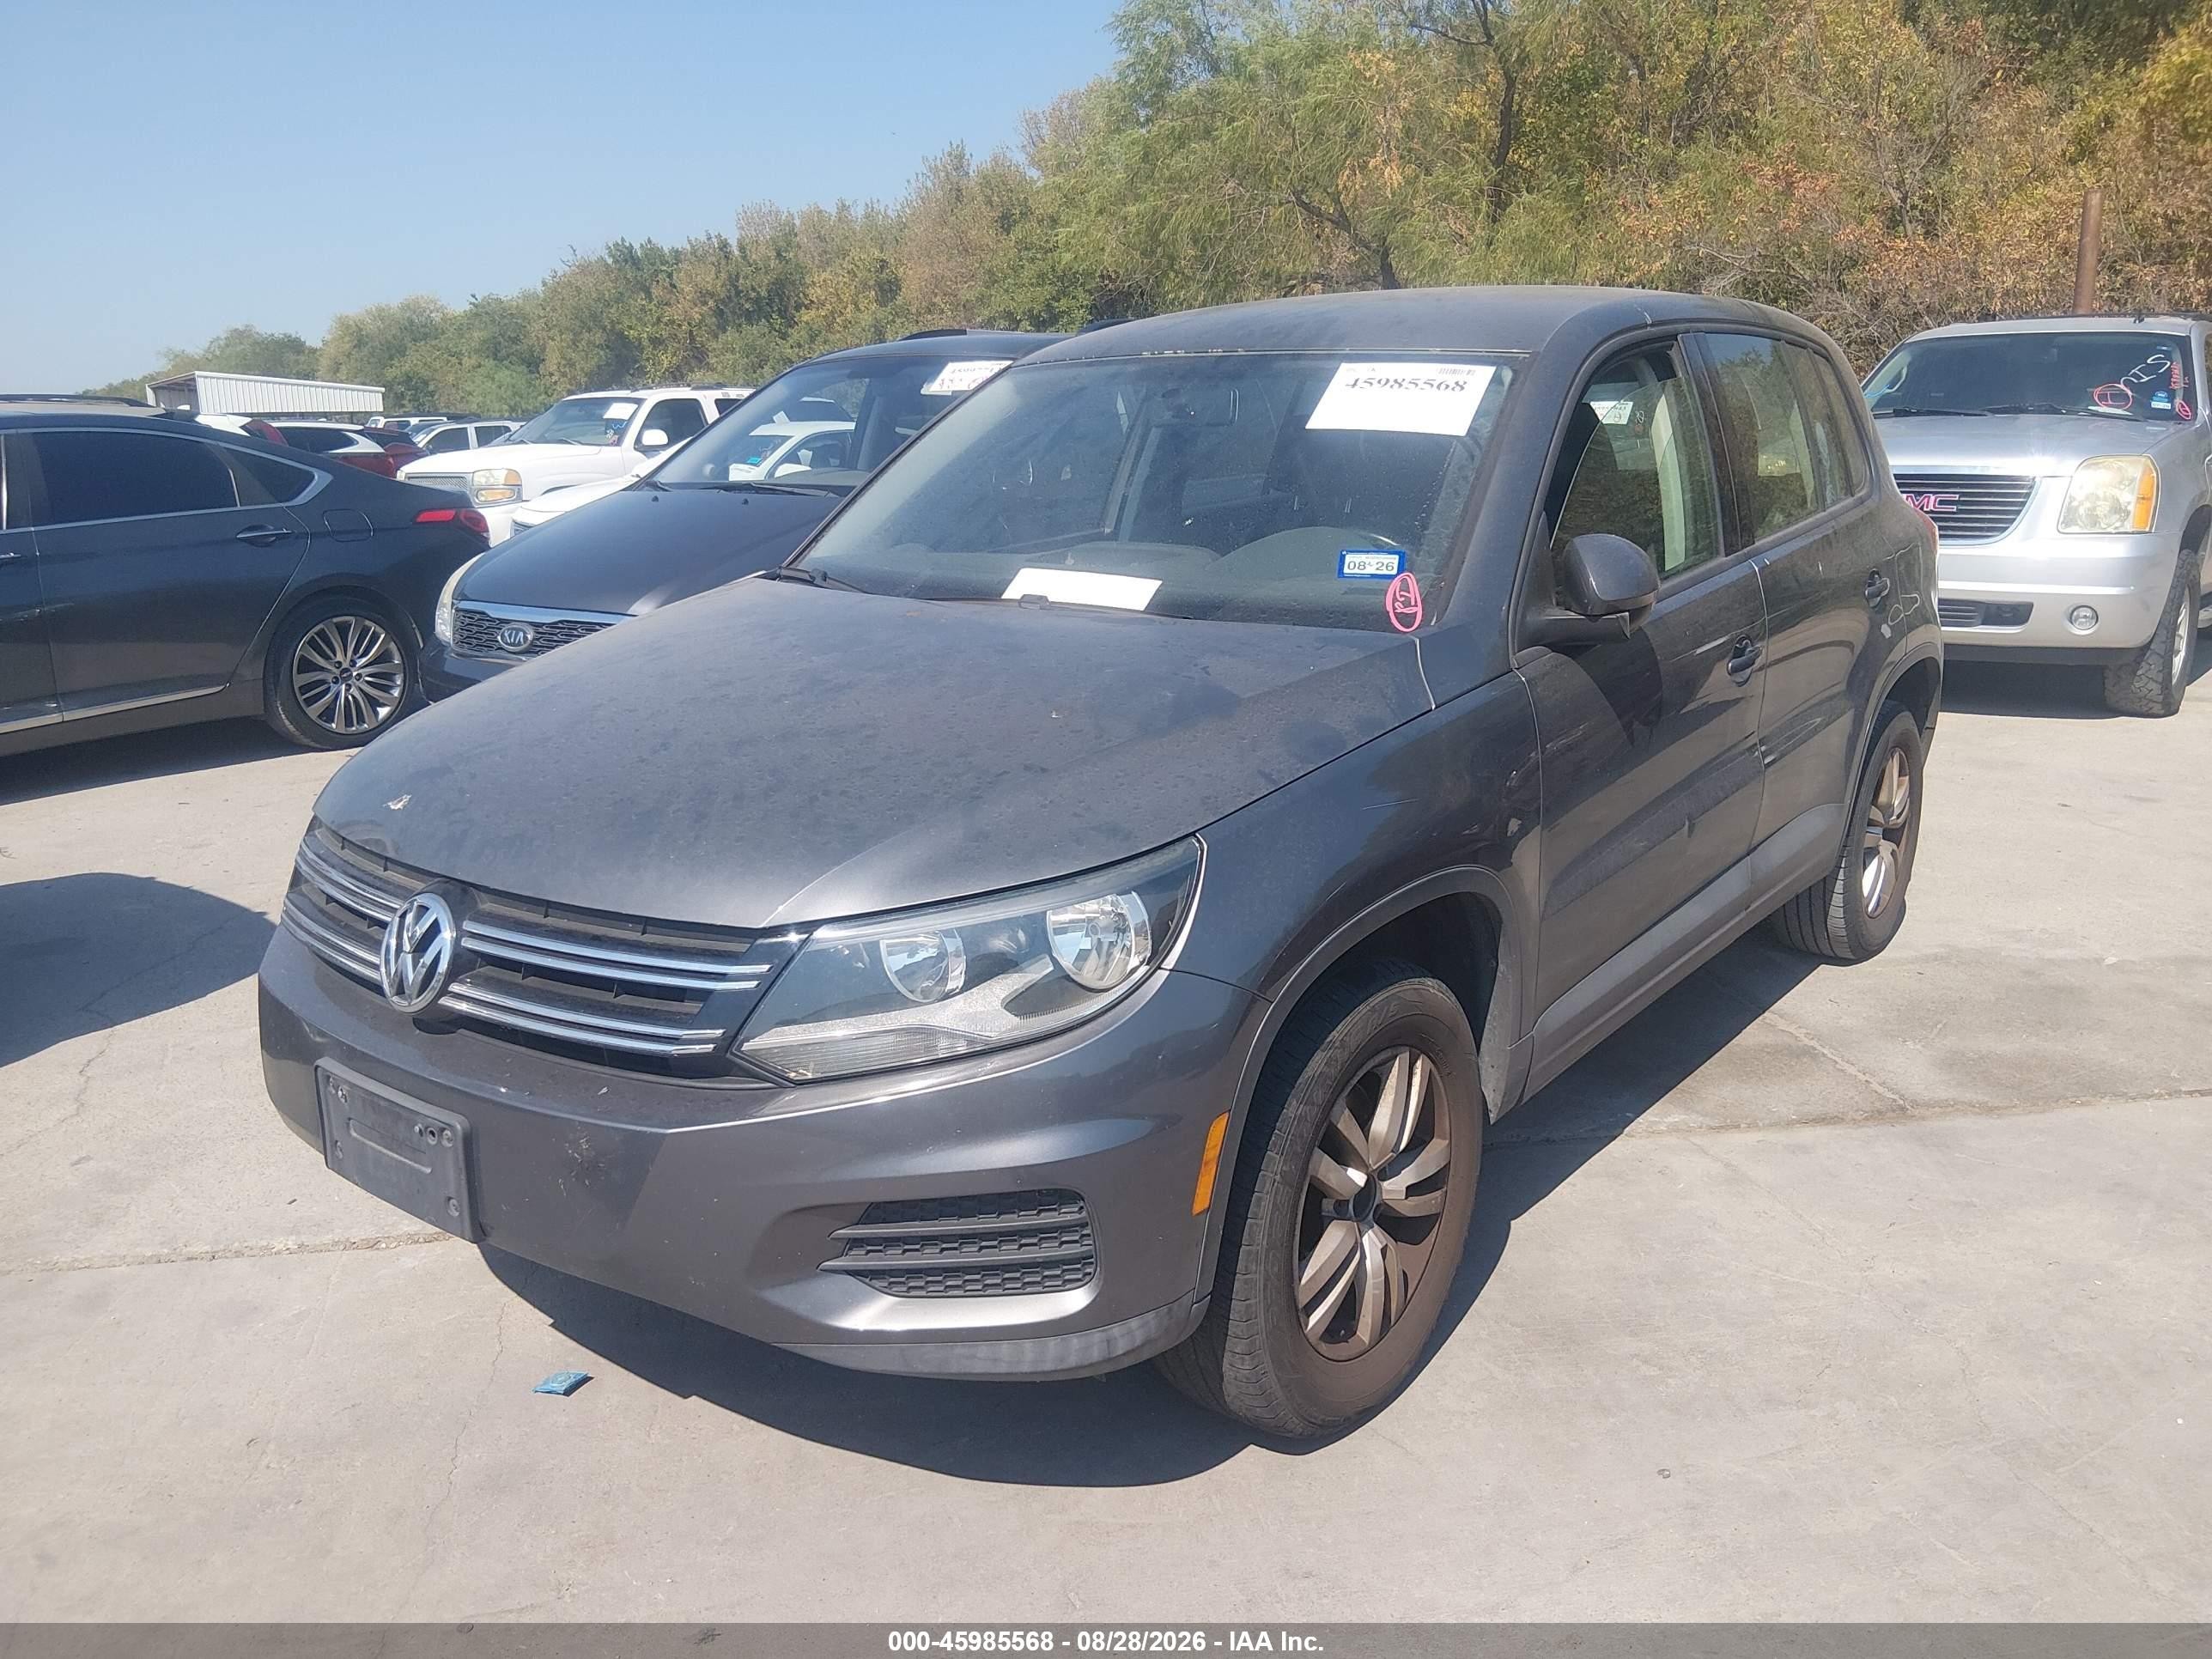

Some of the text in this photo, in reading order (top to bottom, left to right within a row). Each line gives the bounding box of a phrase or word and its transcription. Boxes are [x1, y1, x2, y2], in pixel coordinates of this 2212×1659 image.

[1345, 377, 1468, 392] 45985568
[1902, 493, 1960, 512] MC
[1347, 560, 1395, 572] 08 26
[504, 629, 524, 645] KIA
